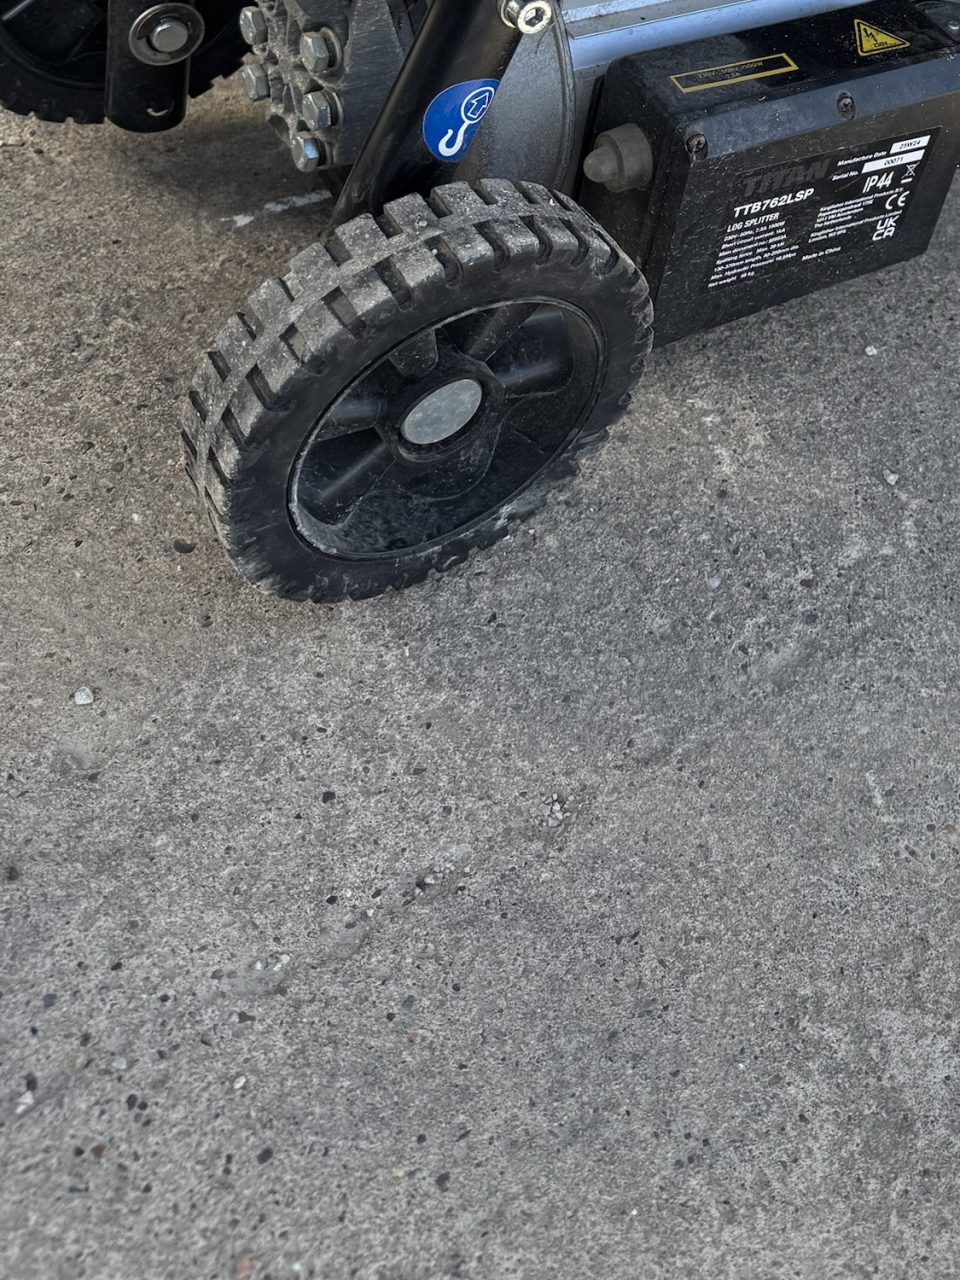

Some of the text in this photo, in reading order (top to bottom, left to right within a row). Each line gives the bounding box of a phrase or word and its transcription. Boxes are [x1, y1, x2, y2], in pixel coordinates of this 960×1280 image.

[837, 155, 873, 166] Manufacture
[832, 172, 849, 180] Serial
[862, 171, 894, 193] IP44
[734, 188, 814, 217] TTB762LSP
[820, 203, 844, 211] Kingfisher
[845, 195, 873, 205] International
[727, 212, 779, 232] LOG SPLITTER
[876, 215, 899, 230] UK
[810, 228, 834, 237] Kingfisher
[872, 227, 895, 240] CA
